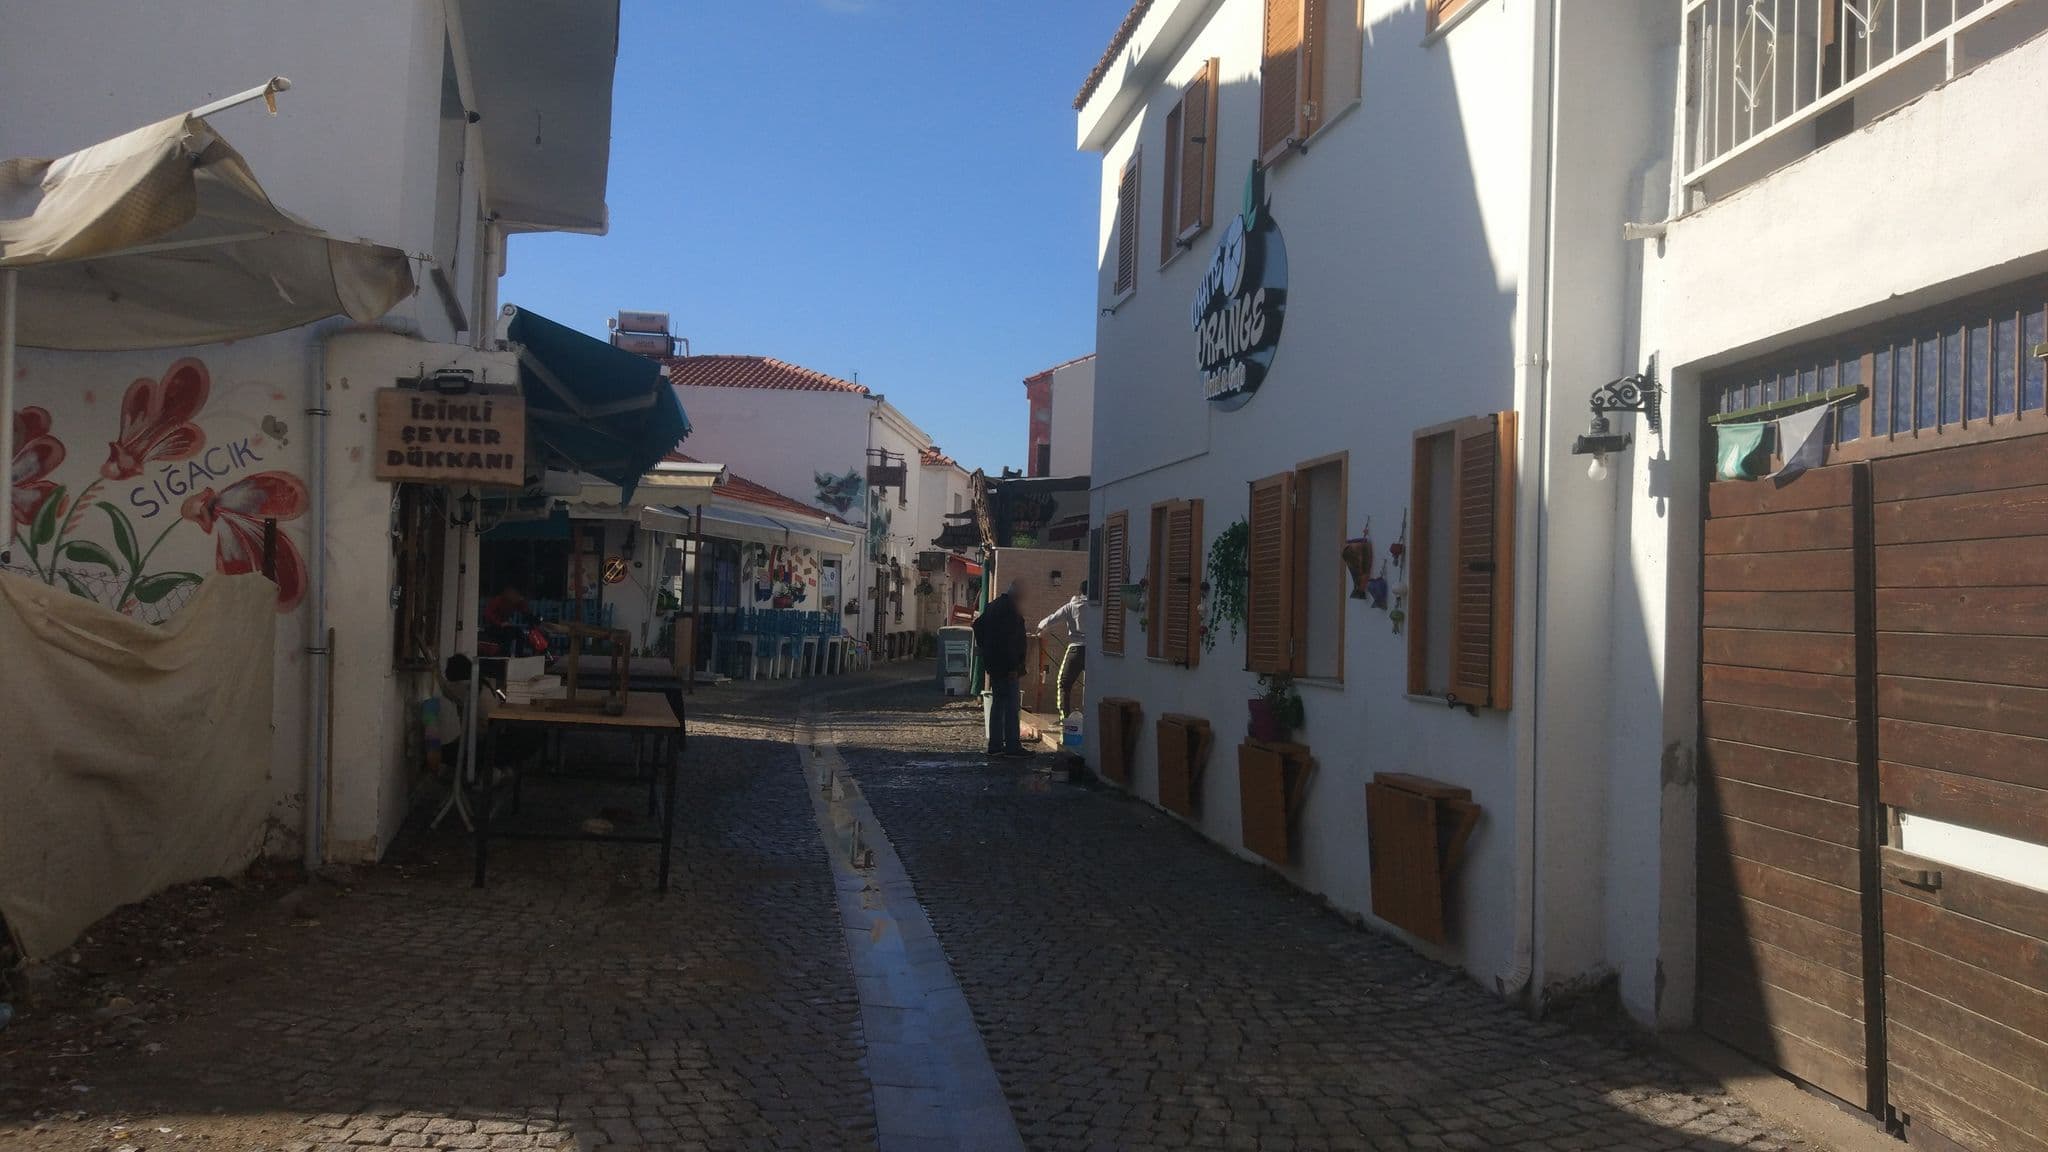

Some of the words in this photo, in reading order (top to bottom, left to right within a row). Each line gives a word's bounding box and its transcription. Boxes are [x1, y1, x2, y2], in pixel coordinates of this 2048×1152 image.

[1198, 288, 1266, 370] ORANGE
[410, 397, 494, 422] İSİMLİ
[401, 425, 501, 445] ŞEYLER
[387, 447, 514, 470] DÜKKANI
[129, 437, 264, 518] SIĞACIK
